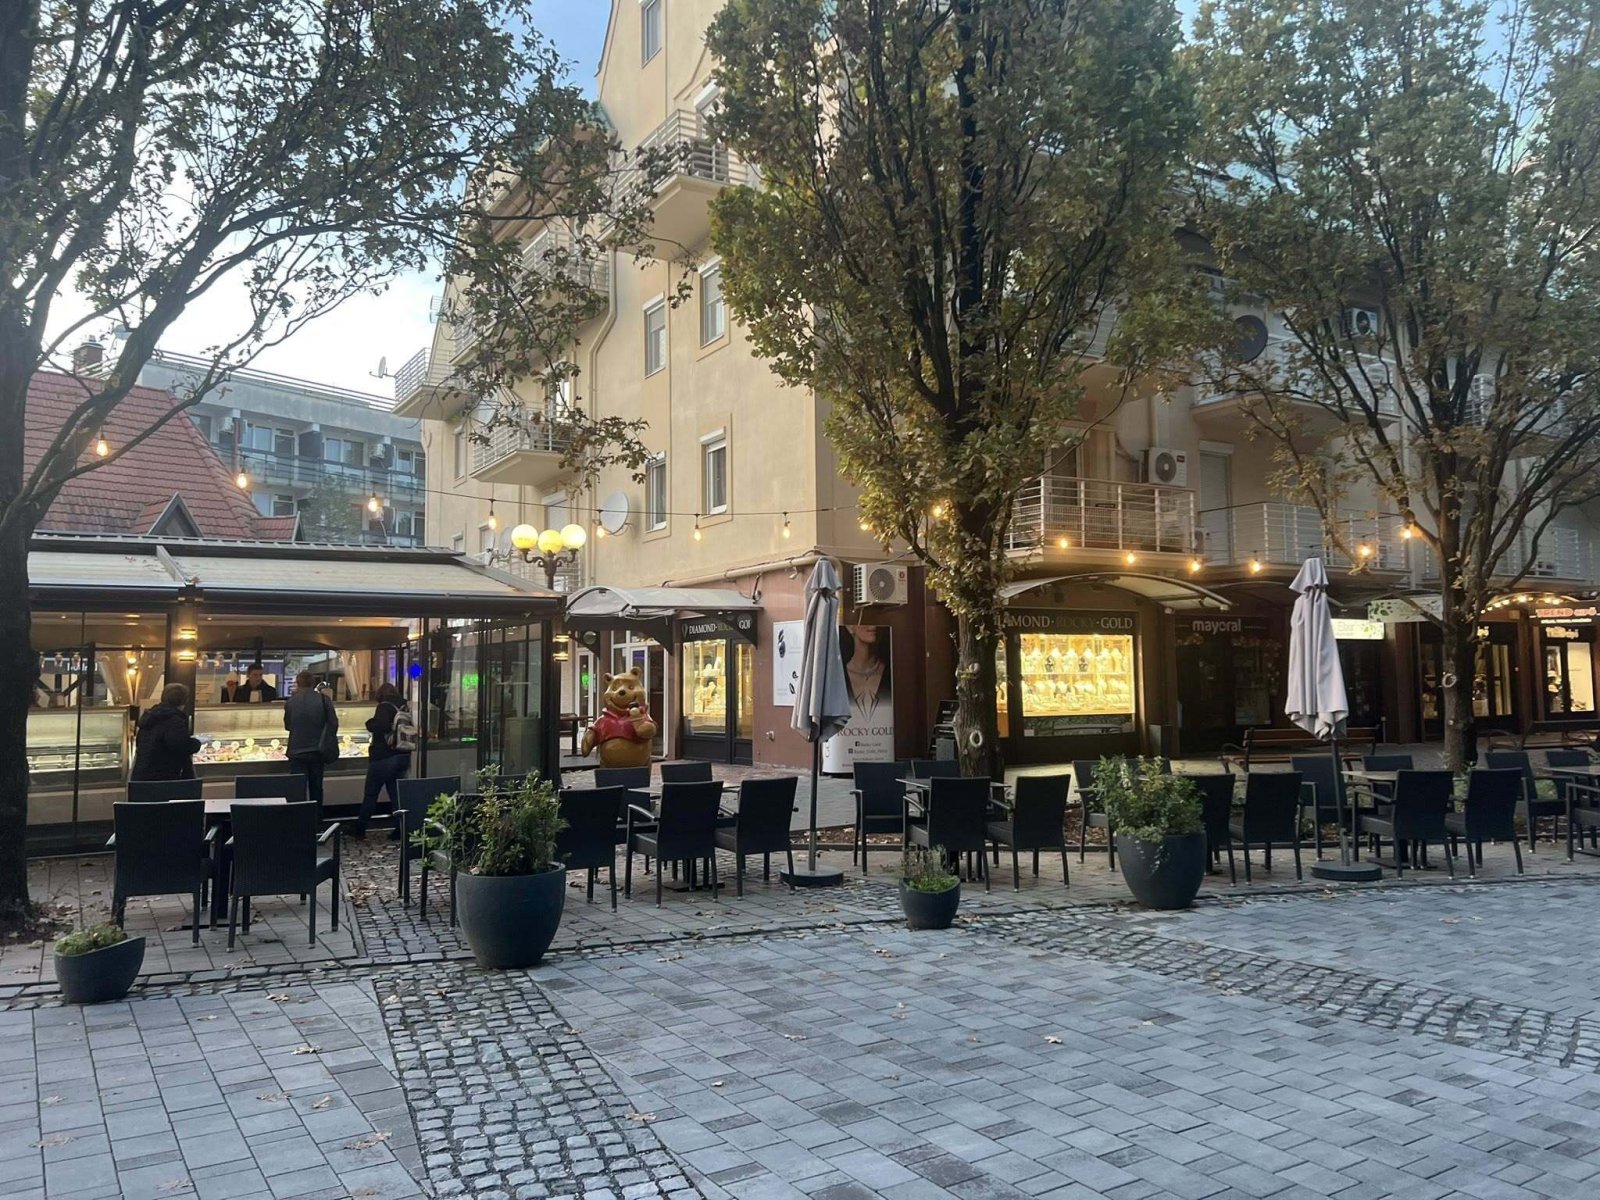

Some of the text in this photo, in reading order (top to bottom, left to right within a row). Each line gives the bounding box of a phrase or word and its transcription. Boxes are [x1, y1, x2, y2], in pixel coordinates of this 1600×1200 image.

[689, 623, 716, 635] DIAMOND
[1101, 617, 1133, 629] GOLD
[1192, 618, 1242, 635] mayoral
